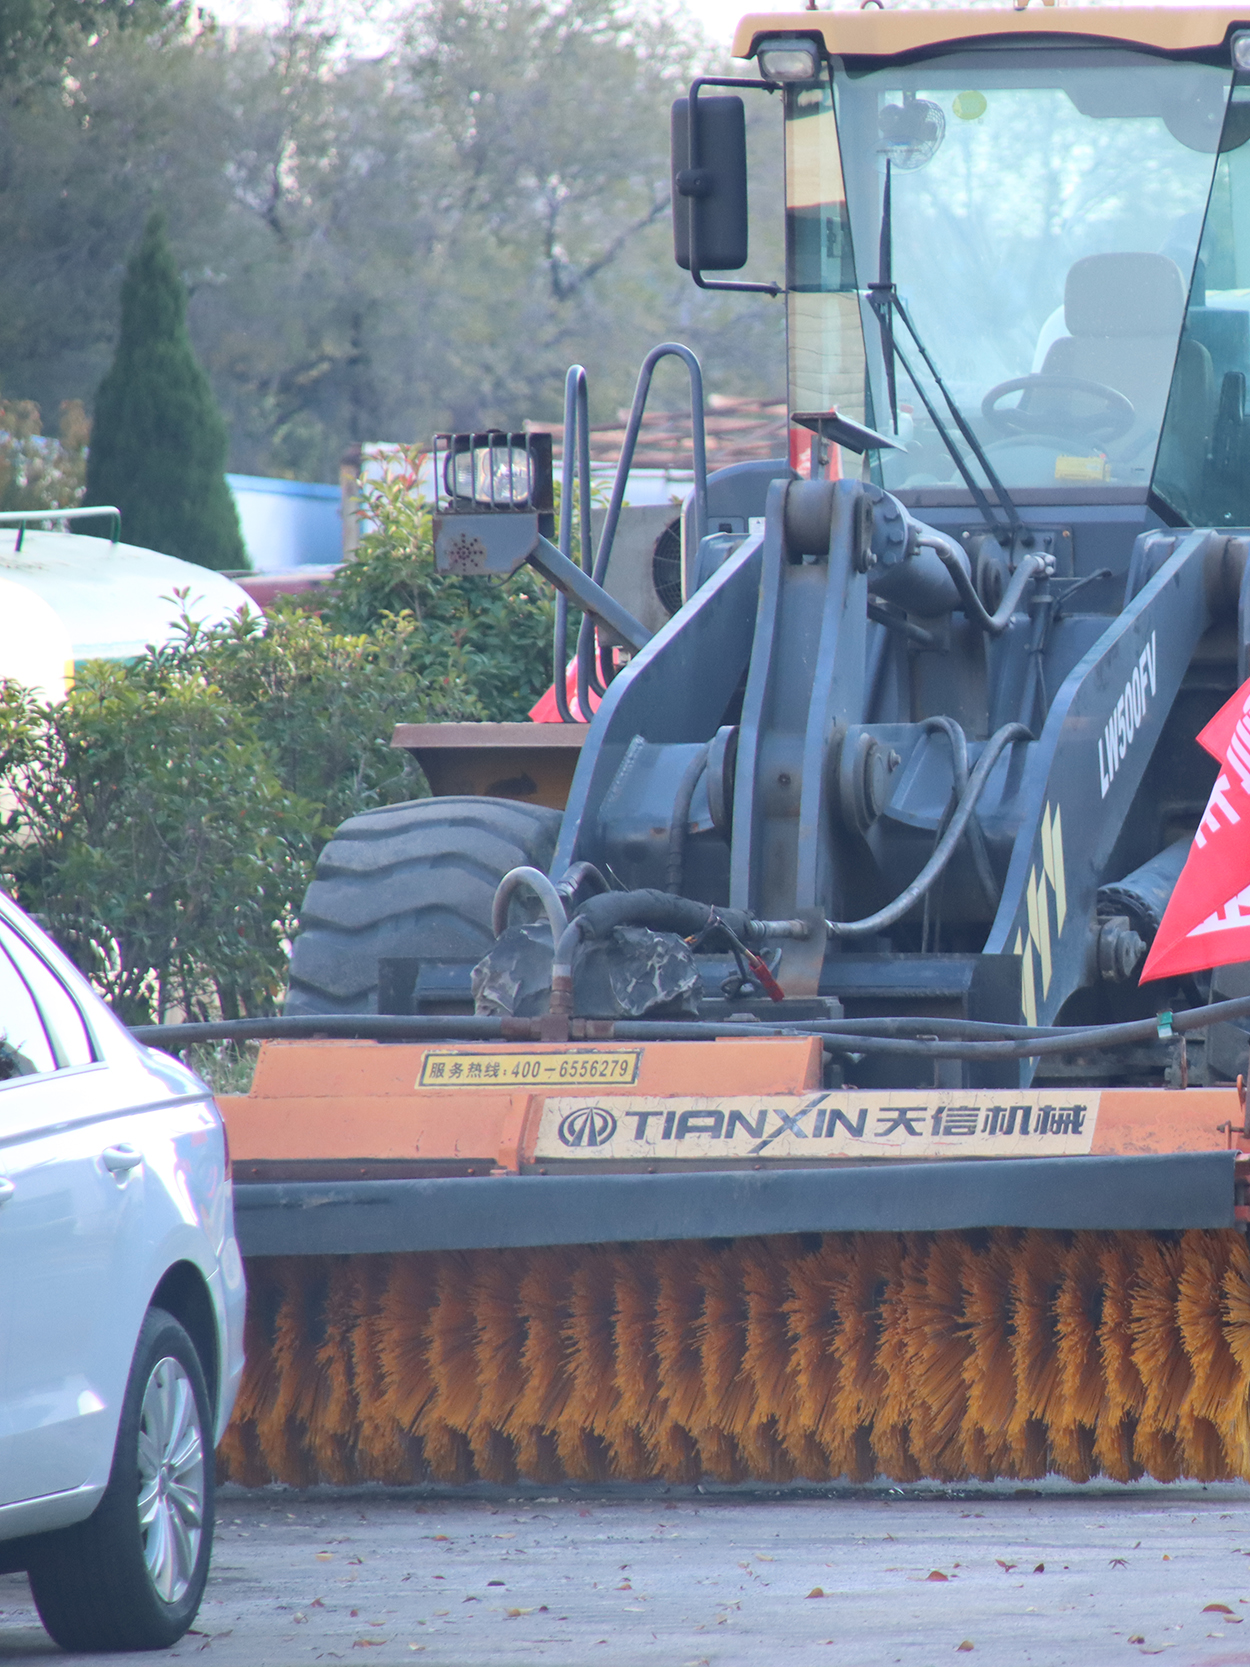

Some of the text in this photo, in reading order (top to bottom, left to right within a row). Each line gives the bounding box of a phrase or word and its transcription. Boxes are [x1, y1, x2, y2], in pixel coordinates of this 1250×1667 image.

[1098, 630, 1156, 799] LW500FV
[625, 1093, 1087, 1154] TIANXIN 天信机械
